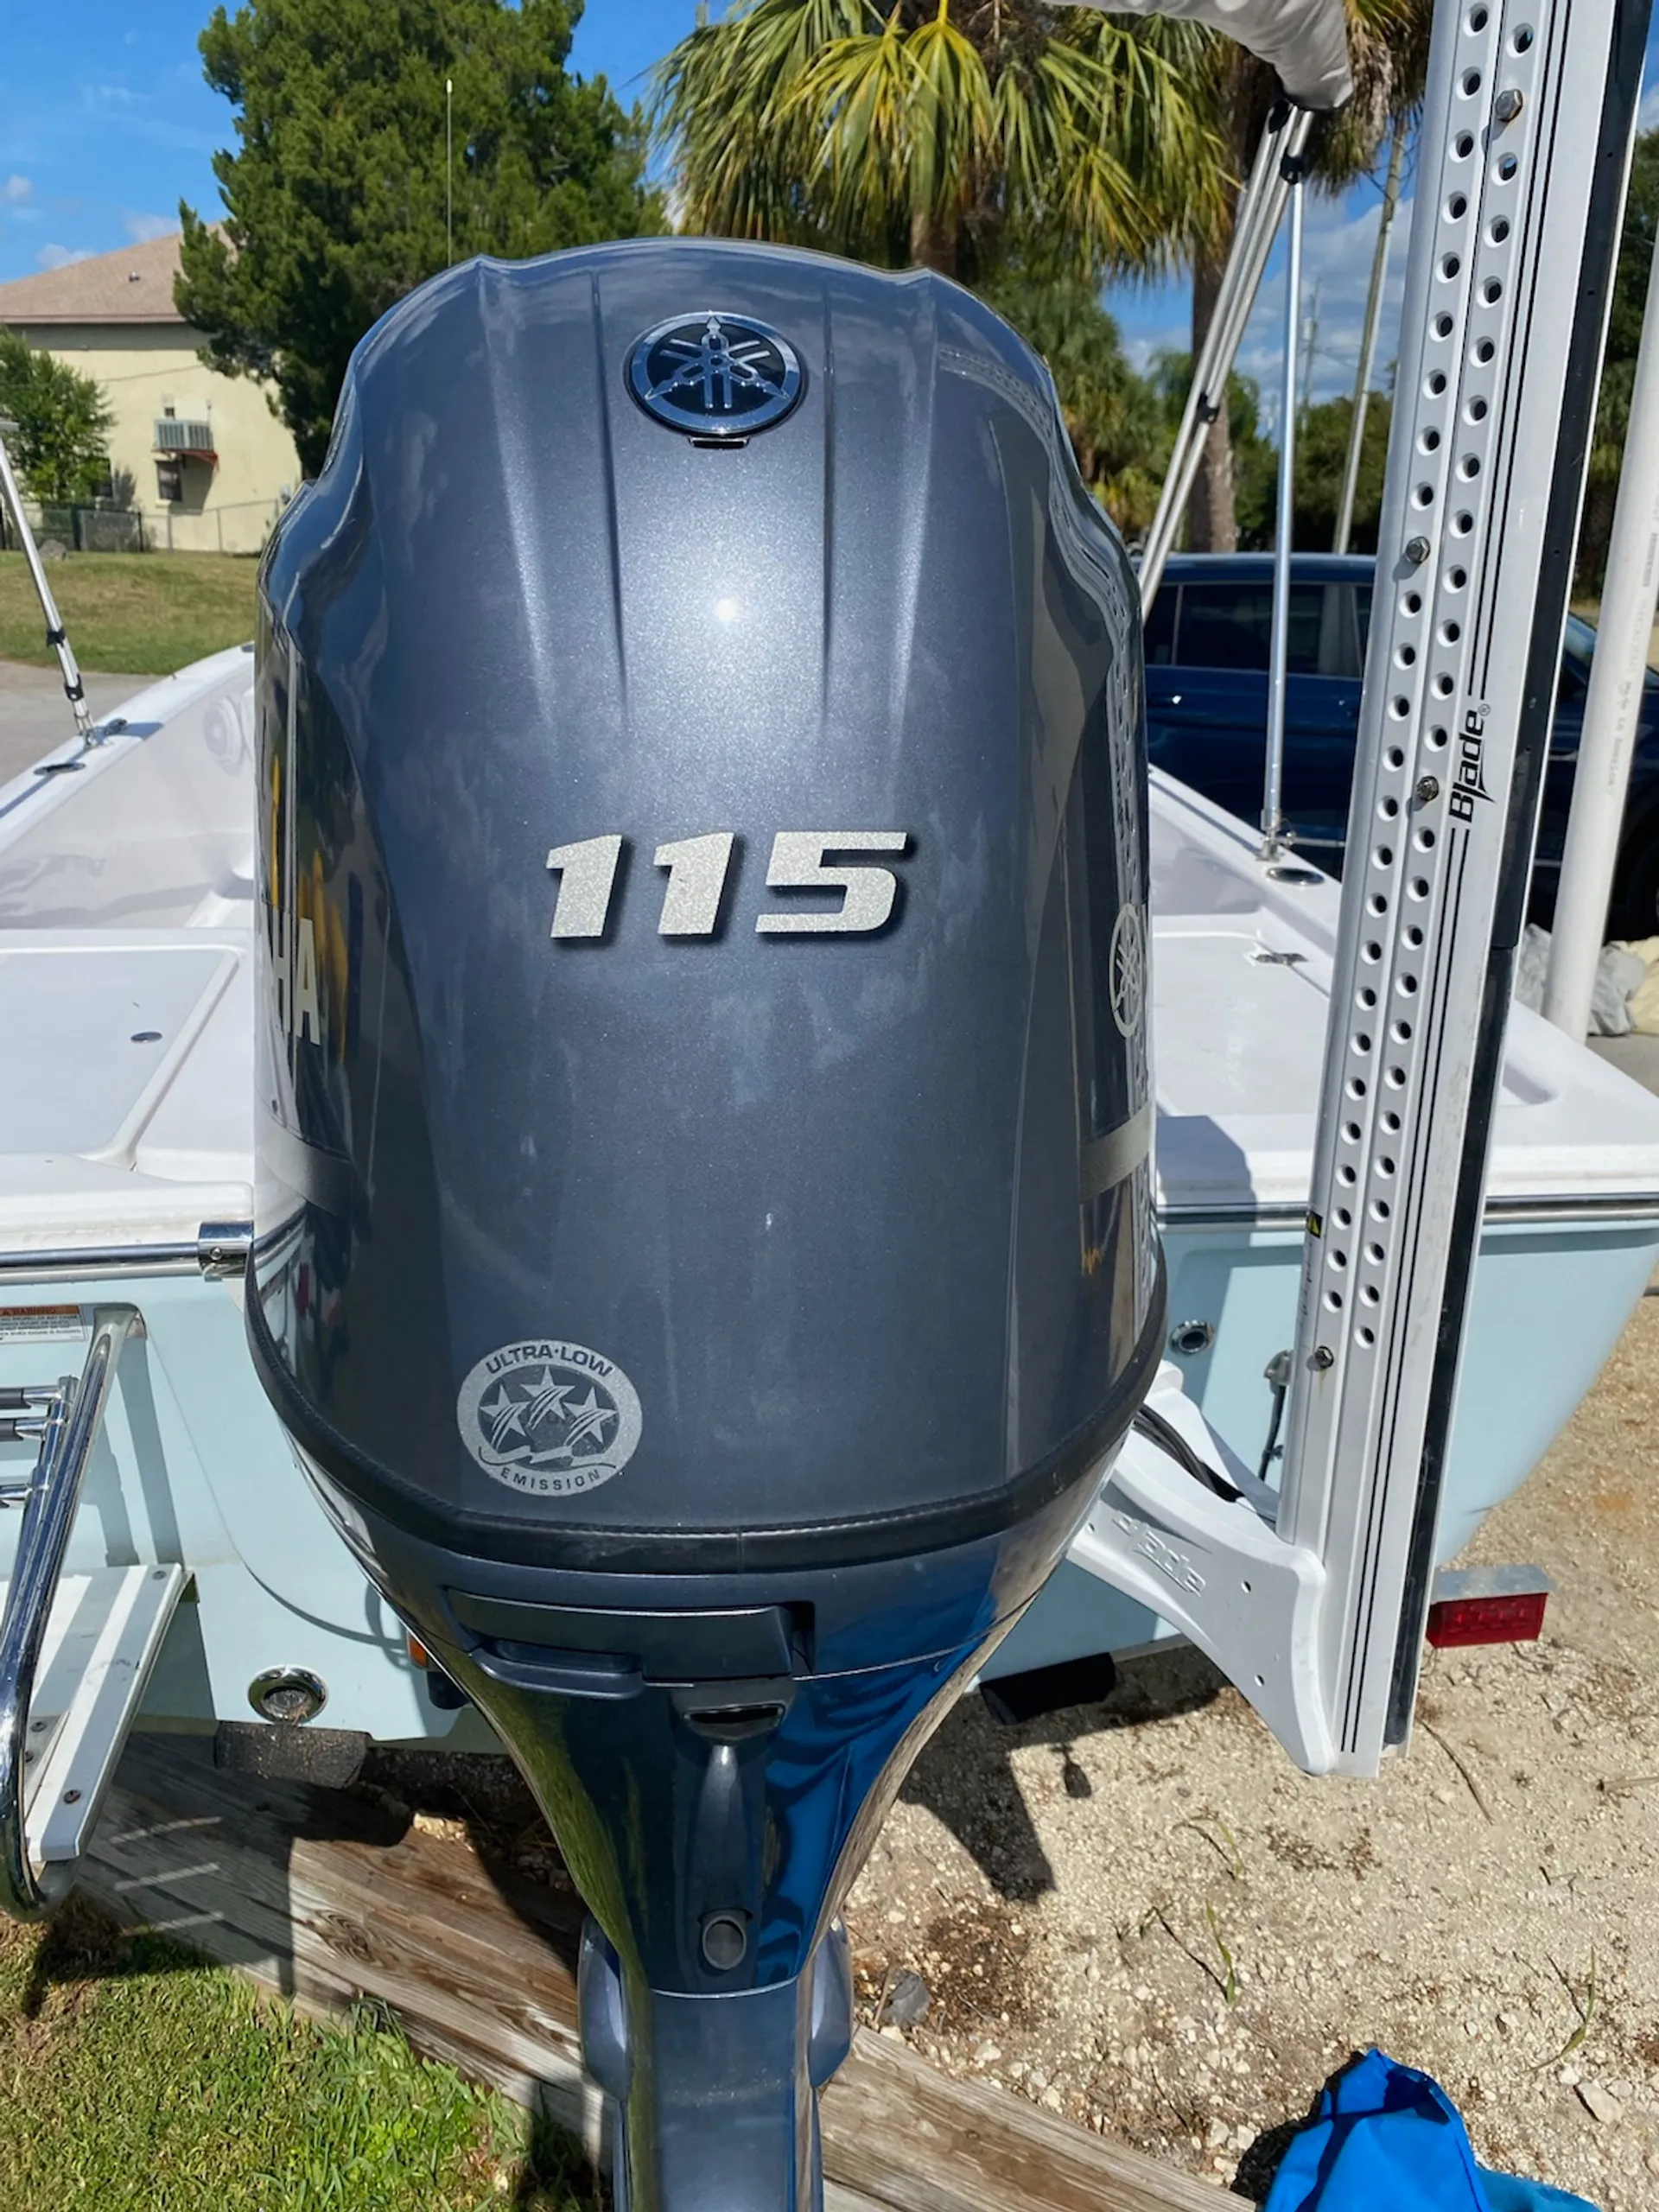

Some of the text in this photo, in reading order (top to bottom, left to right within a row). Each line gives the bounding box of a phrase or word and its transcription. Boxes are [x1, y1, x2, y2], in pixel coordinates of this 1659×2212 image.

[545, 831, 907, 938] 115
[268, 906, 321, 1046] HA
[499, 1466, 601, 1491] EMISSION
